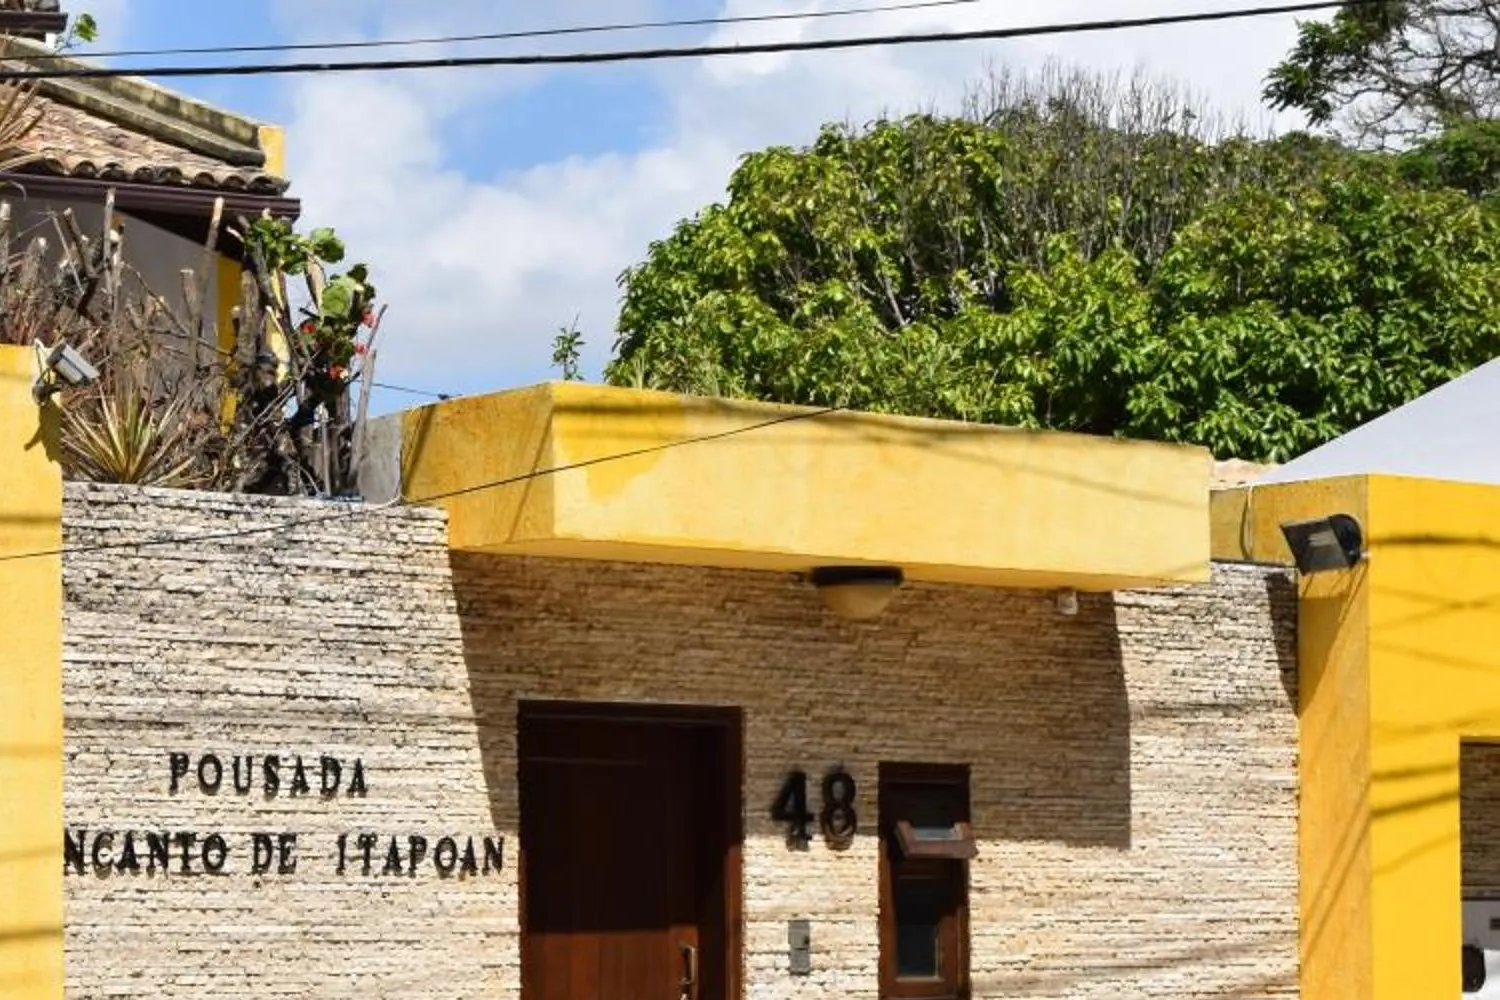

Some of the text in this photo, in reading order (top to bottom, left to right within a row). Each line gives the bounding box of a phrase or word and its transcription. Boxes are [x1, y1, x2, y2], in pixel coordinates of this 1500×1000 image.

[168, 752, 368, 800] POUSADA
[771, 770, 857, 852] 48
[63, 828, 504, 880] NCANTO DE ITAPOAN
